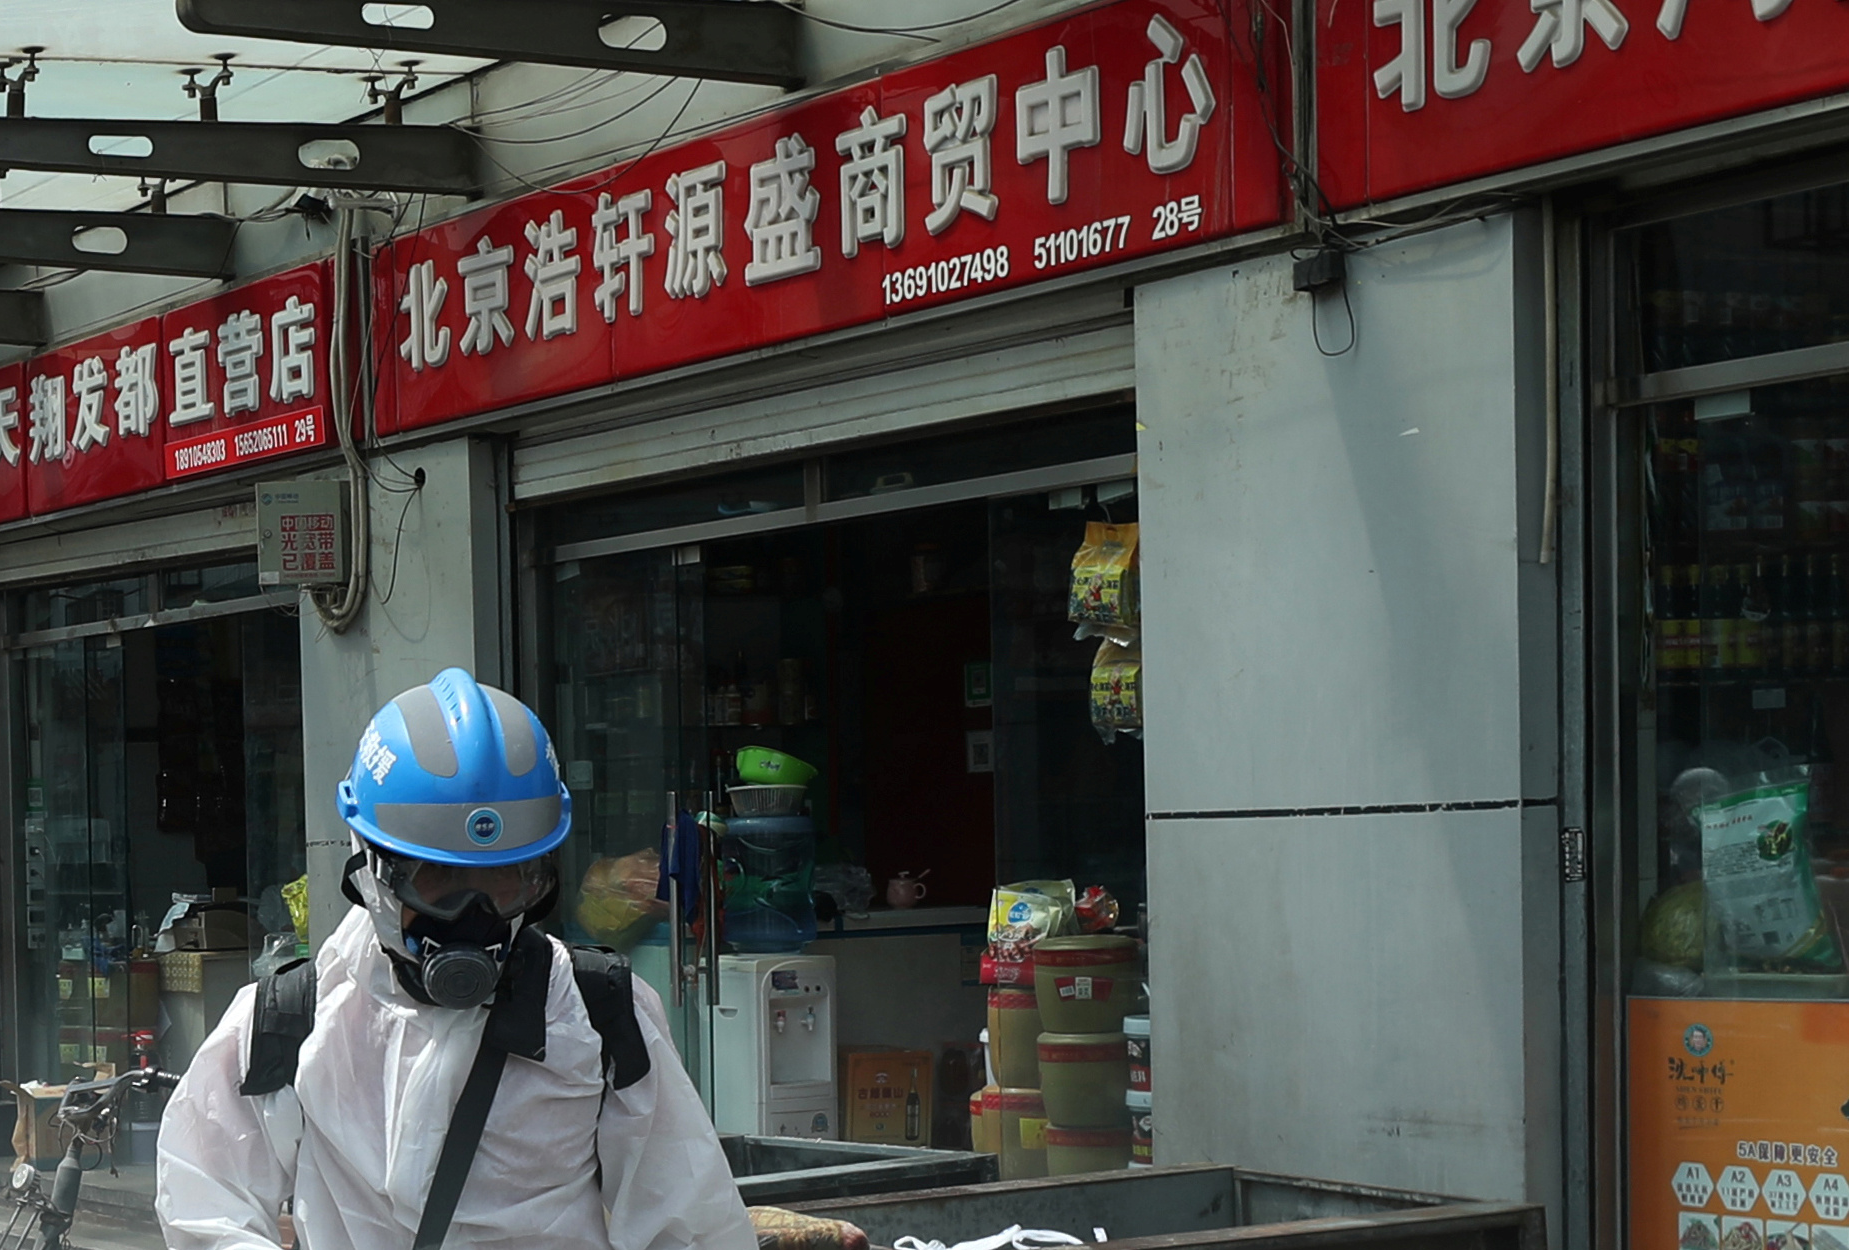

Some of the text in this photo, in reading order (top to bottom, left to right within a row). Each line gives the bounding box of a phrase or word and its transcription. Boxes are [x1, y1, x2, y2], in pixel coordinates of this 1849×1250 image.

[399, 13, 1216, 371] 北京浩轩源盛商贸中心
[882, 195, 1202, 305] 13691027498 51101677 28号
[294, 414, 316, 443] 29号
[1737, 1140, 1837, 1167] 5A保障更安全
[1686, 1167, 1700, 1180] A1
[1731, 1171, 1746, 1183] A2
[1776, 1175, 1792, 1187] A3
[1823, 1179, 1839, 1191] A4
